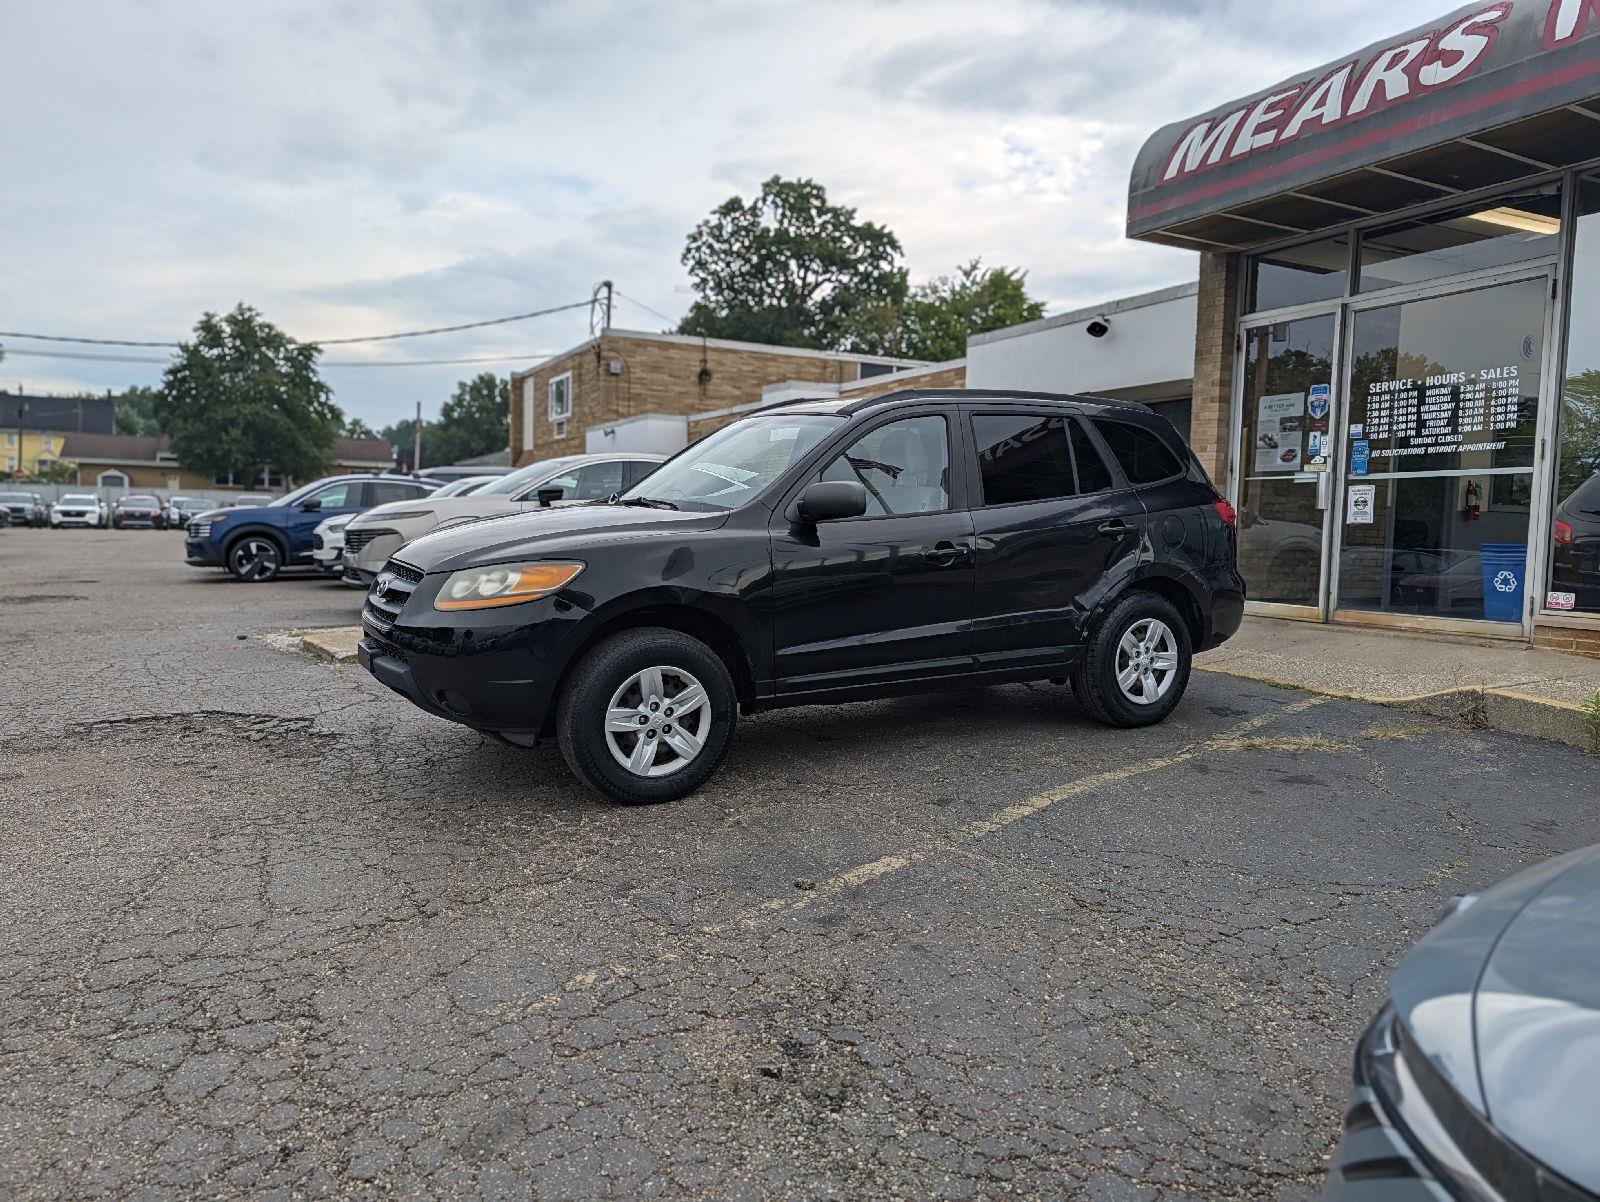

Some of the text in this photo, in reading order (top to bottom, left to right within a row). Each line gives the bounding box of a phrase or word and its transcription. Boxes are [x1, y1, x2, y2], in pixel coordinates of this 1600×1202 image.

[1160, 6, 1508, 184] MEARS
[1369, 365, 1518, 393] SERVICE HOURS SALES
[1425, 387, 1452, 397] MONDAY
[1475, 383, 1486, 391] AM
[1508, 379, 1519, 387] PM
[1380, 409, 1390, 417] AM
[1408, 406, 1417, 414] PM
[1420, 402, 1456, 412] WEDNESDAY
[1474, 399, 1485, 407] AM
[1490, 397, 1506, 406] 6:00
[1507, 396, 1518, 404] PM
[1381, 401, 1390, 409] AM
[1408, 398, 1418, 406] PM
[1425, 395, 1452, 404] TUESDAY
[1475, 391, 1486, 399] AM
[1508, 387, 1519, 395] PM
[1379, 424, 1389, 432] AM
[1426, 418, 1448, 428] FRIDAY
[1458, 417, 1473, 425] 9:00
[1473, 415, 1484, 423] AM
[1490, 414, 1506, 422] 6:00
[1506, 413, 1517, 421] PM
[1380, 416, 1390, 424] AM
[1420, 410, 1452, 420] THURSDAY
[1458, 408, 1473, 416] 8:30
[1473, 407, 1484, 415] AM
[1507, 404, 1518, 412] PM
[1379, 431, 1389, 439] AM
[1421, 426, 1452, 436] SATURDAY
[1473, 423, 1483, 431] AM
[1506, 421, 1517, 429] PM
[1410, 434, 1463, 445] SUNDAY CLOSED
[1371, 449, 1381, 458] NO
[1427, 444, 1458, 454] WITHOUT
[1458, 441, 1506, 452] APPOINTMENT
